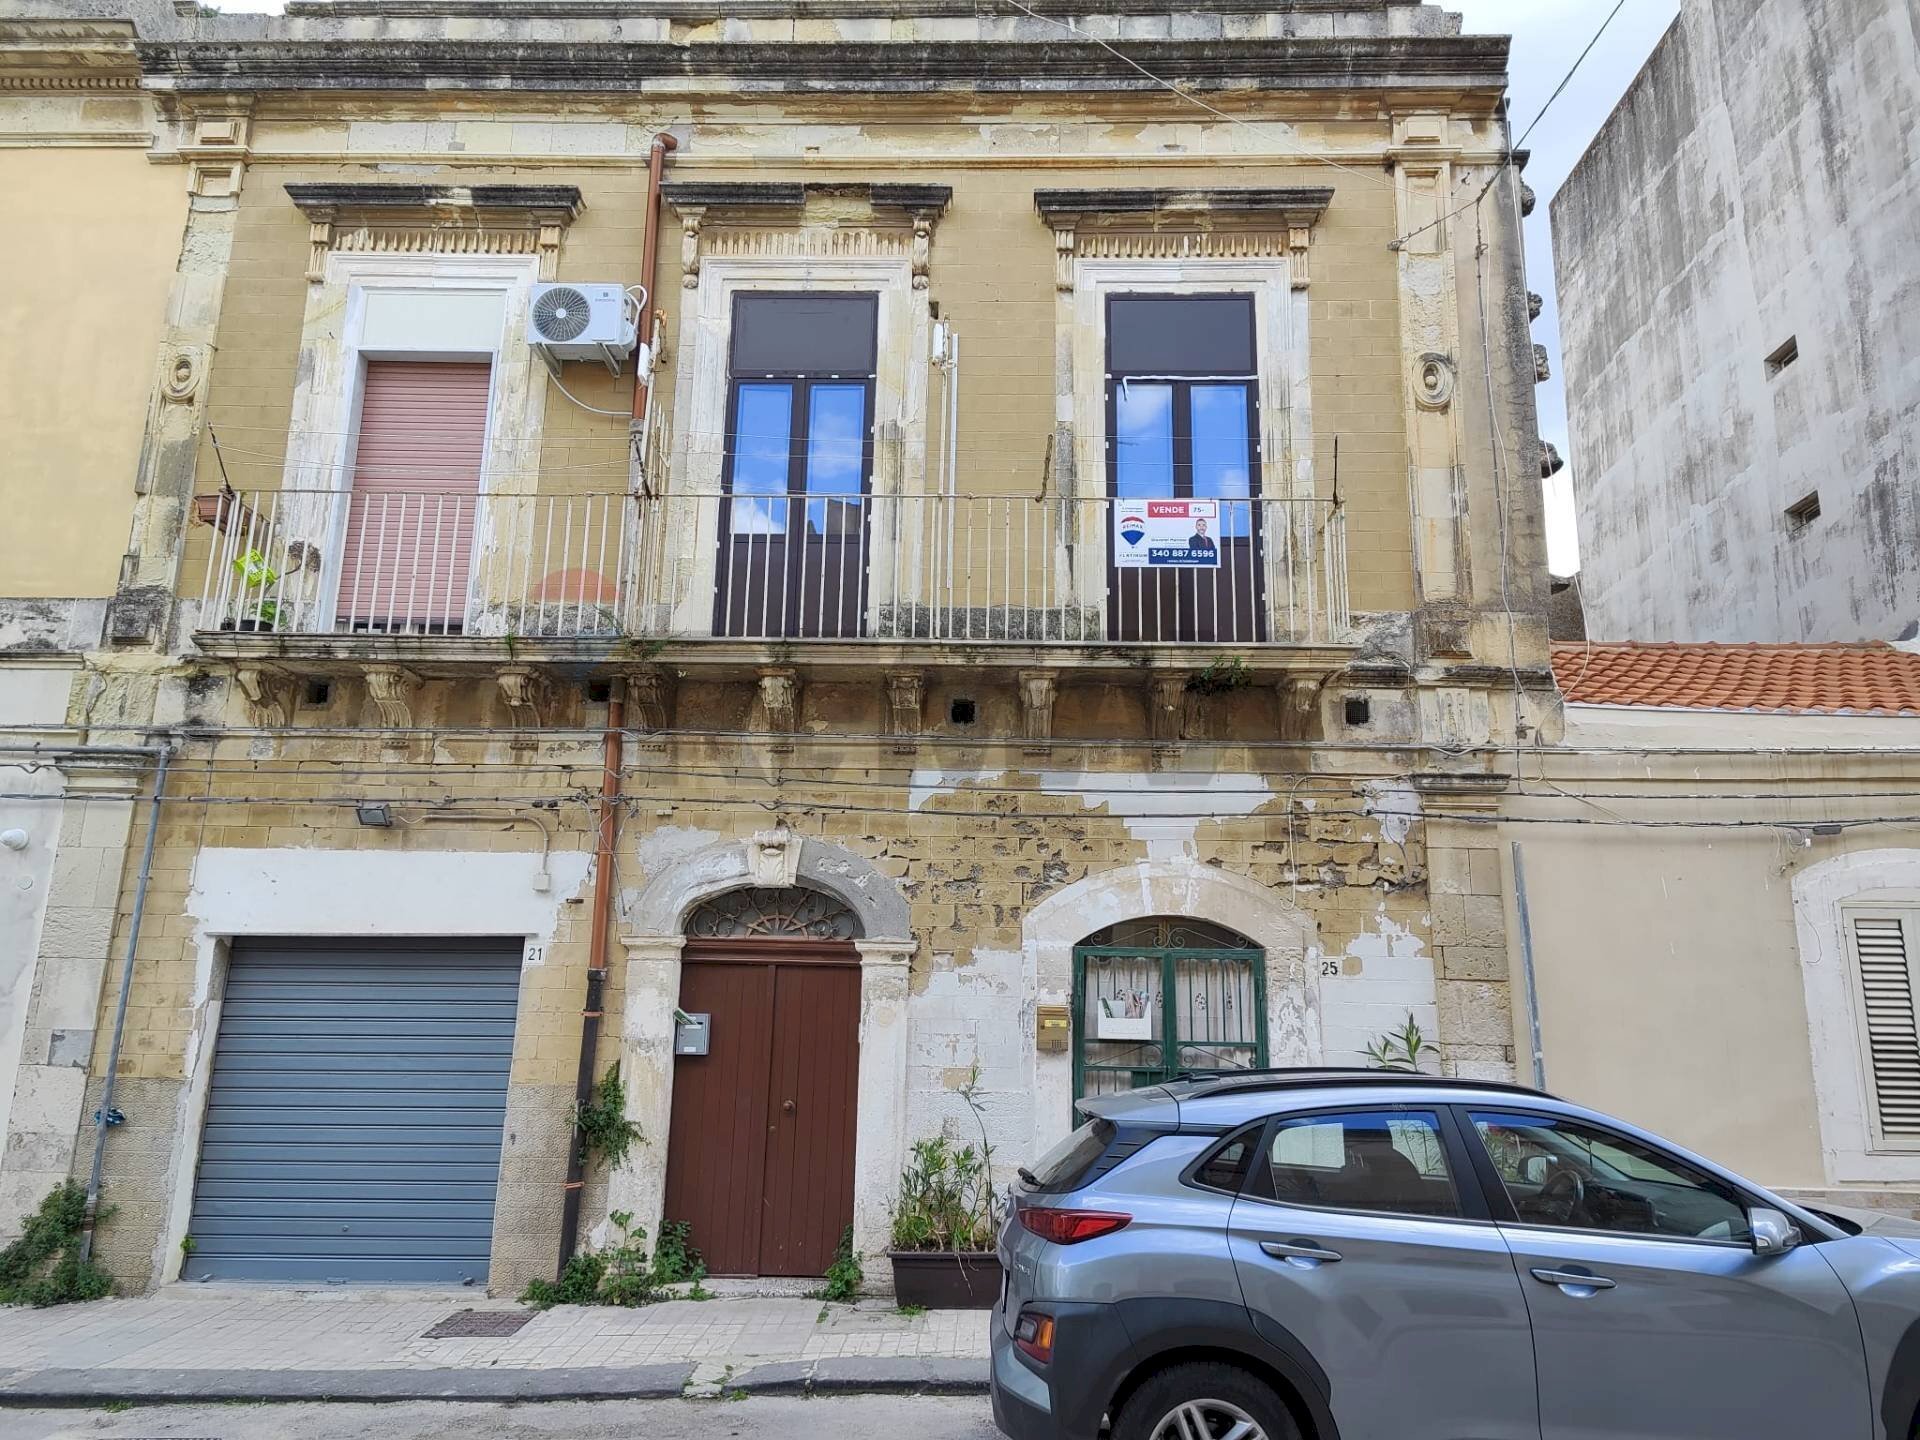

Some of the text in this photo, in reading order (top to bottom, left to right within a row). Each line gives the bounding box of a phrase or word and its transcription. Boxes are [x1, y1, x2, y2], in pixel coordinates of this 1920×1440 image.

[1152, 506, 1185, 514] VENDE
[1151, 549, 1214, 558] 340 887 6596
[528, 948, 542, 961] 21
[1322, 961, 1338, 976] 25
